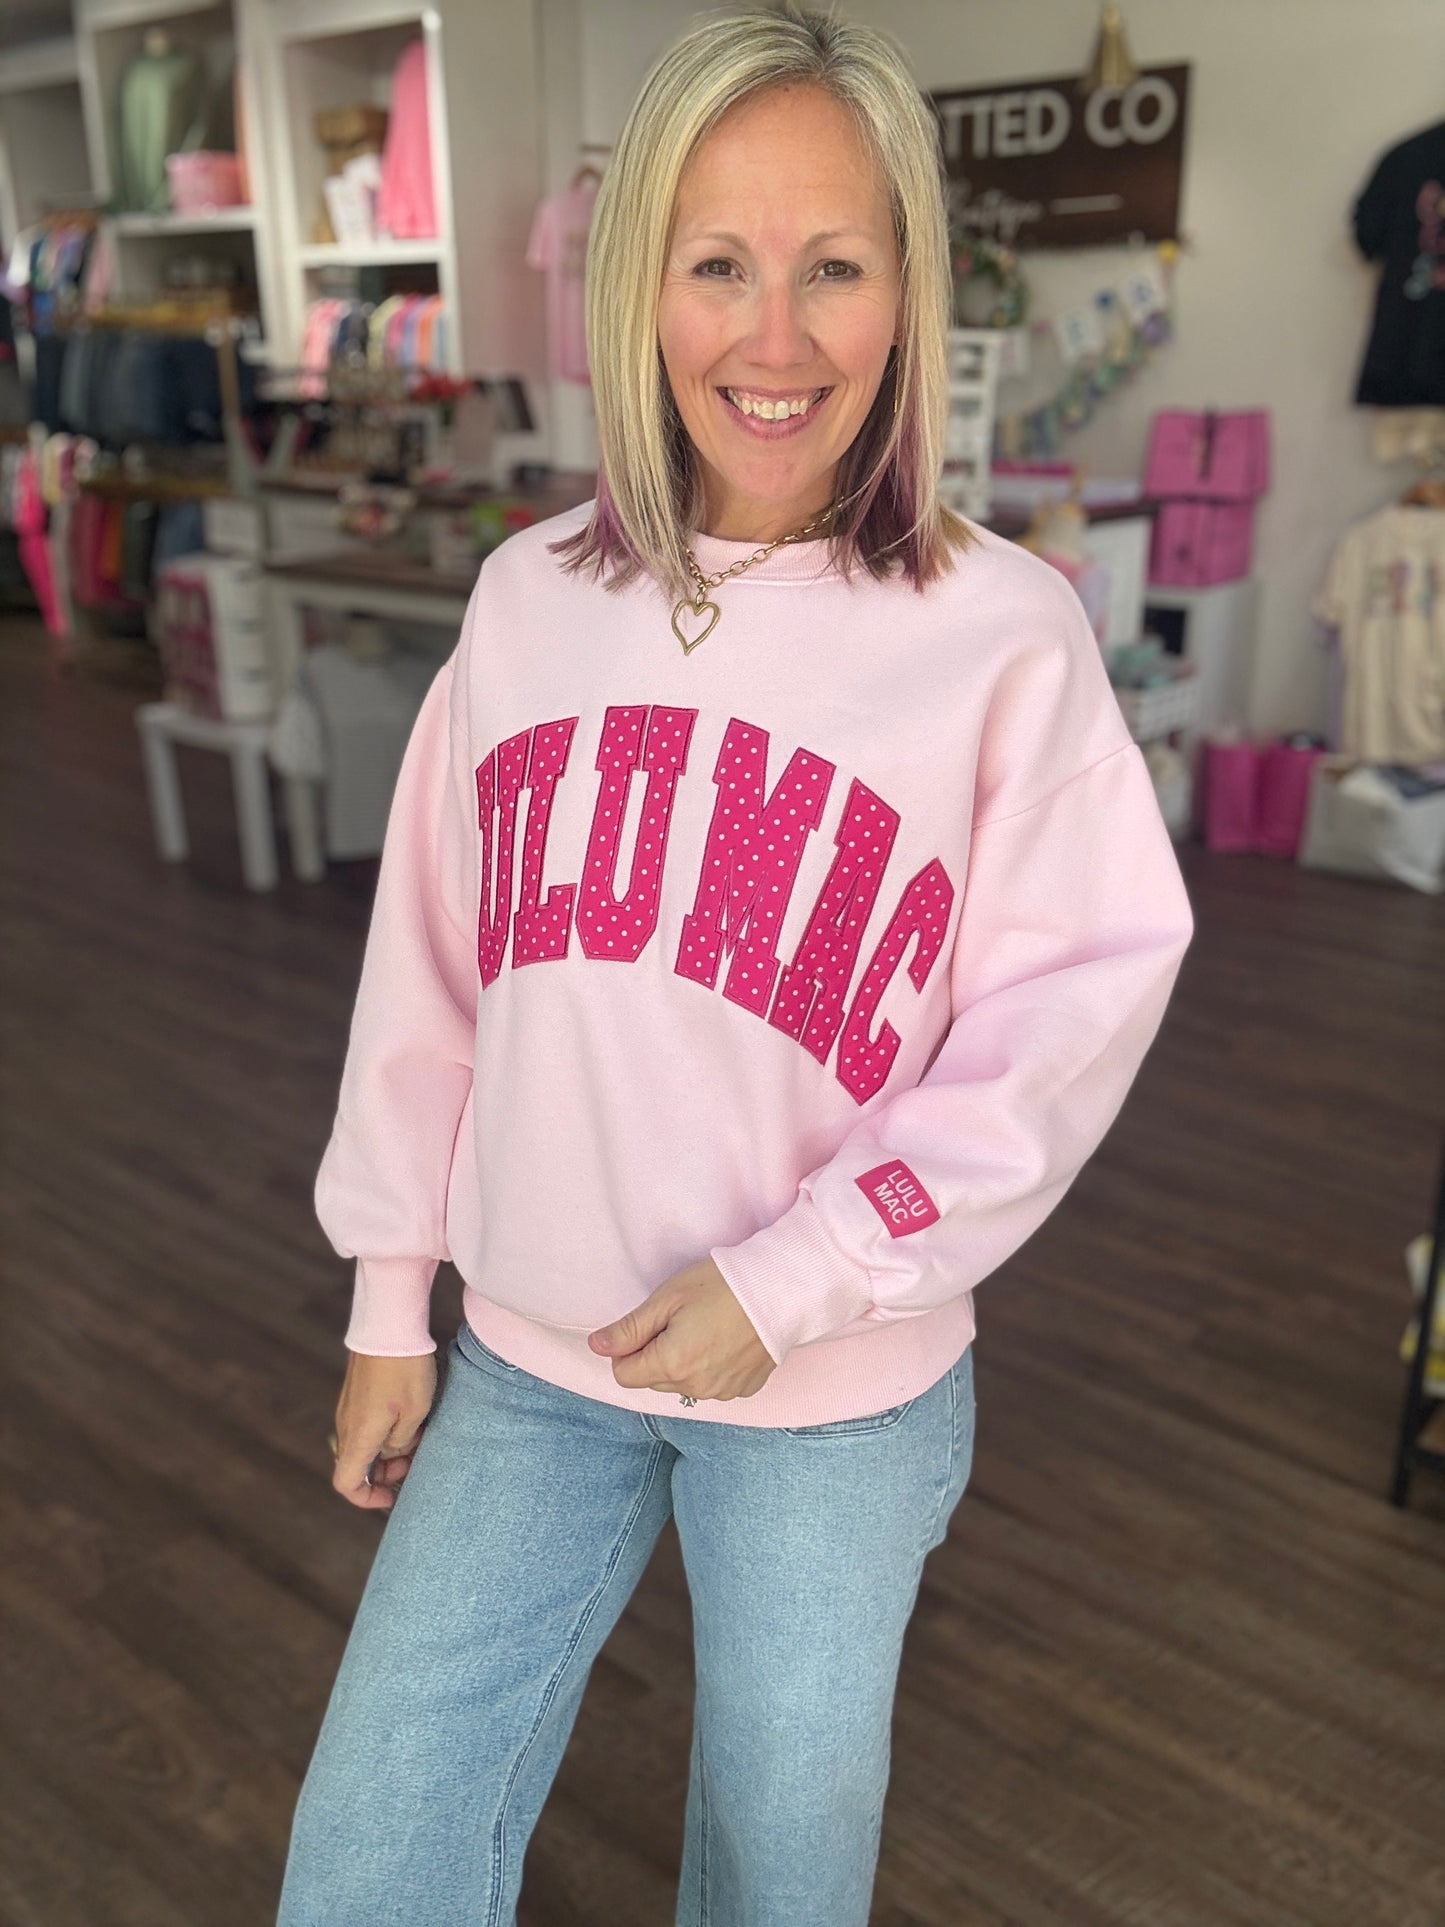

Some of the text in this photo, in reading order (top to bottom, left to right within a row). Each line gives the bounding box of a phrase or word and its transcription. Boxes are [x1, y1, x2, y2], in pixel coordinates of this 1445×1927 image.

[940, 76, 1178, 159] TTED CO
[476, 704, 955, 1106] ULU MAC
[873, 1182, 908, 1224] MAC
[887, 1169, 929, 1217] LULU
